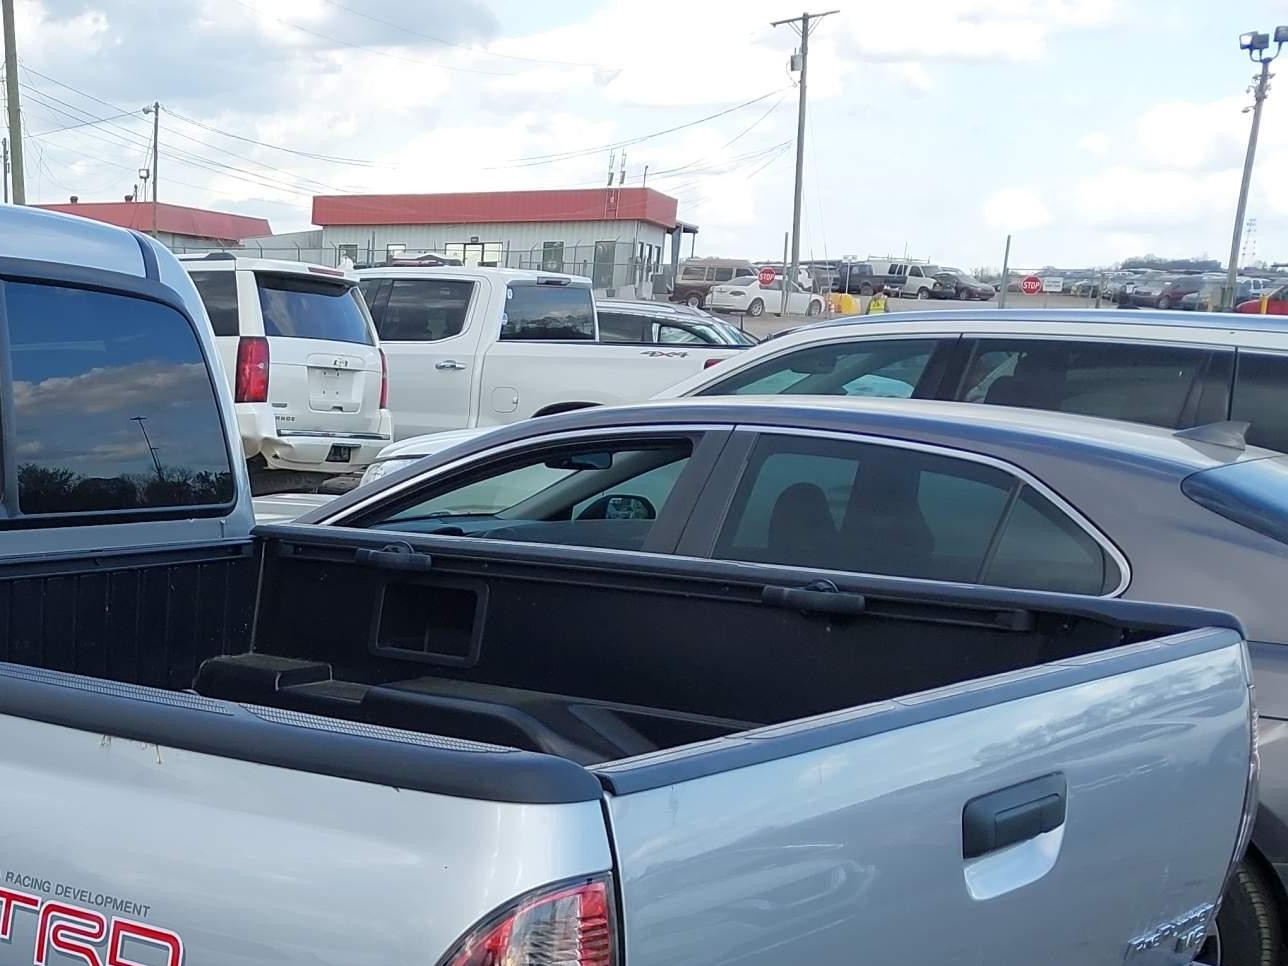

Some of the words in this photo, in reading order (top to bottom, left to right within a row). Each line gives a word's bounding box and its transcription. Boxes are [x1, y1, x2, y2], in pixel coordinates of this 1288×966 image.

[759, 272, 775, 281] STOP
[1023, 281, 1041, 290] STOP
[5, 871, 51, 893] RACING
[54, 884, 151, 918] DEVELOPMENT
